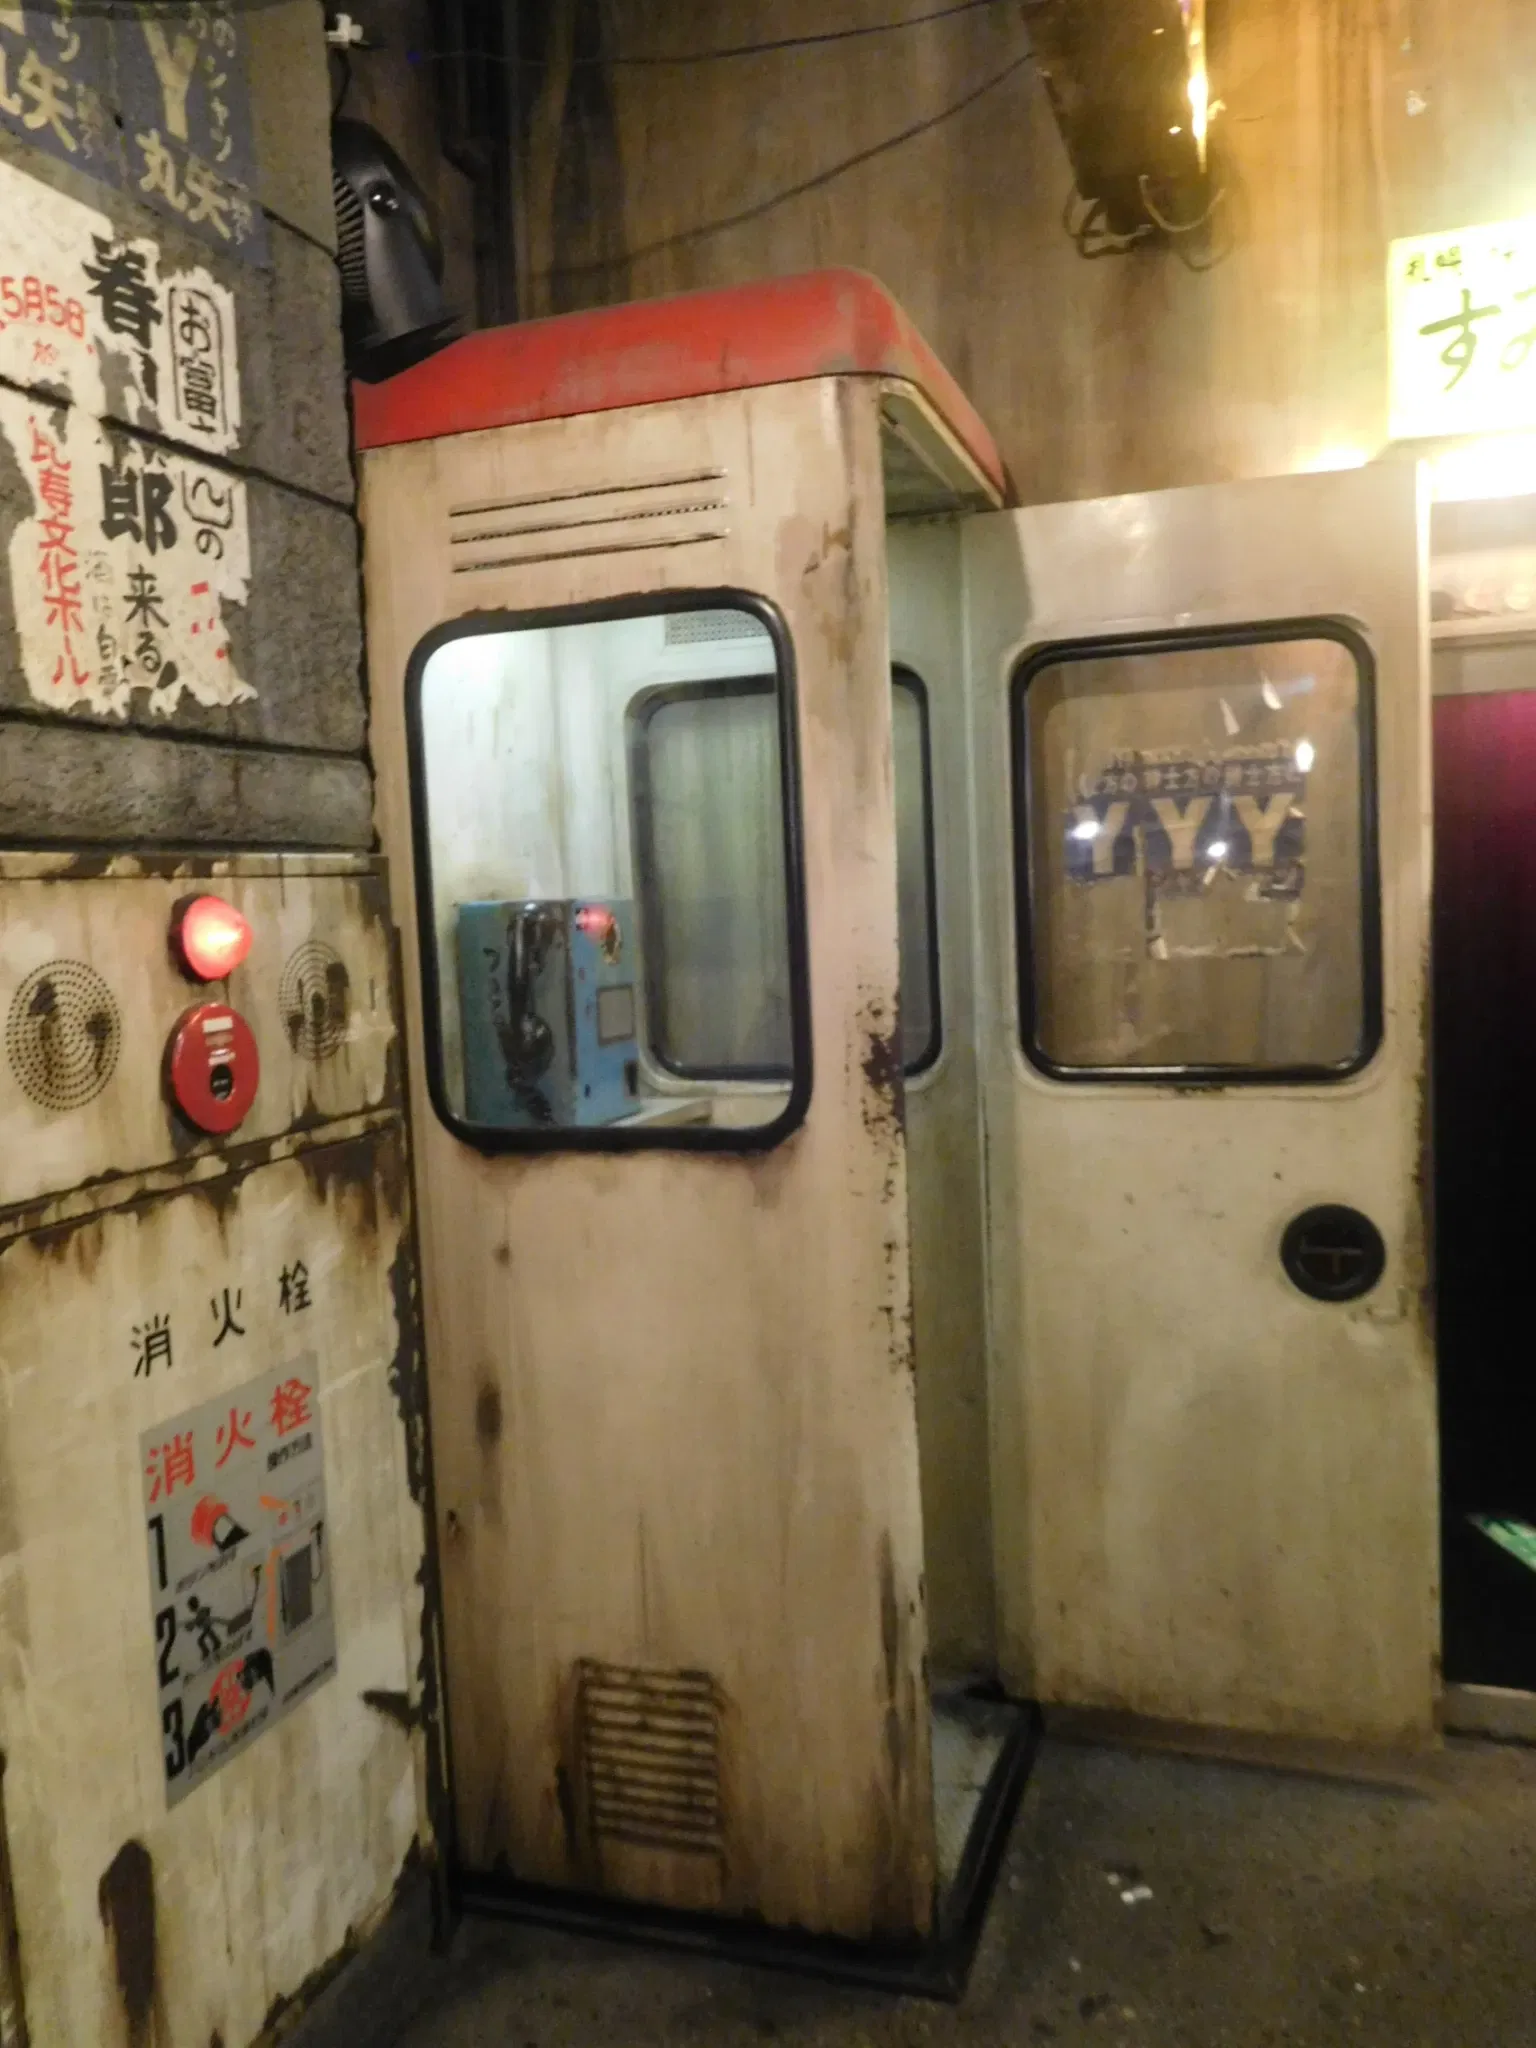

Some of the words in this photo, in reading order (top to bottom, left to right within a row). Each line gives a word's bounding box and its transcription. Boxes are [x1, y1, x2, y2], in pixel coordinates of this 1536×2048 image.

[139, 12, 199, 142] Y
[130, 1259, 313, 1378] 消火栓
[145, 1377, 313, 1504] 消火栓
[148, 1513, 167, 1591] 1
[156, 1604, 180, 1689] 2
[163, 1697, 186, 1781] 3
